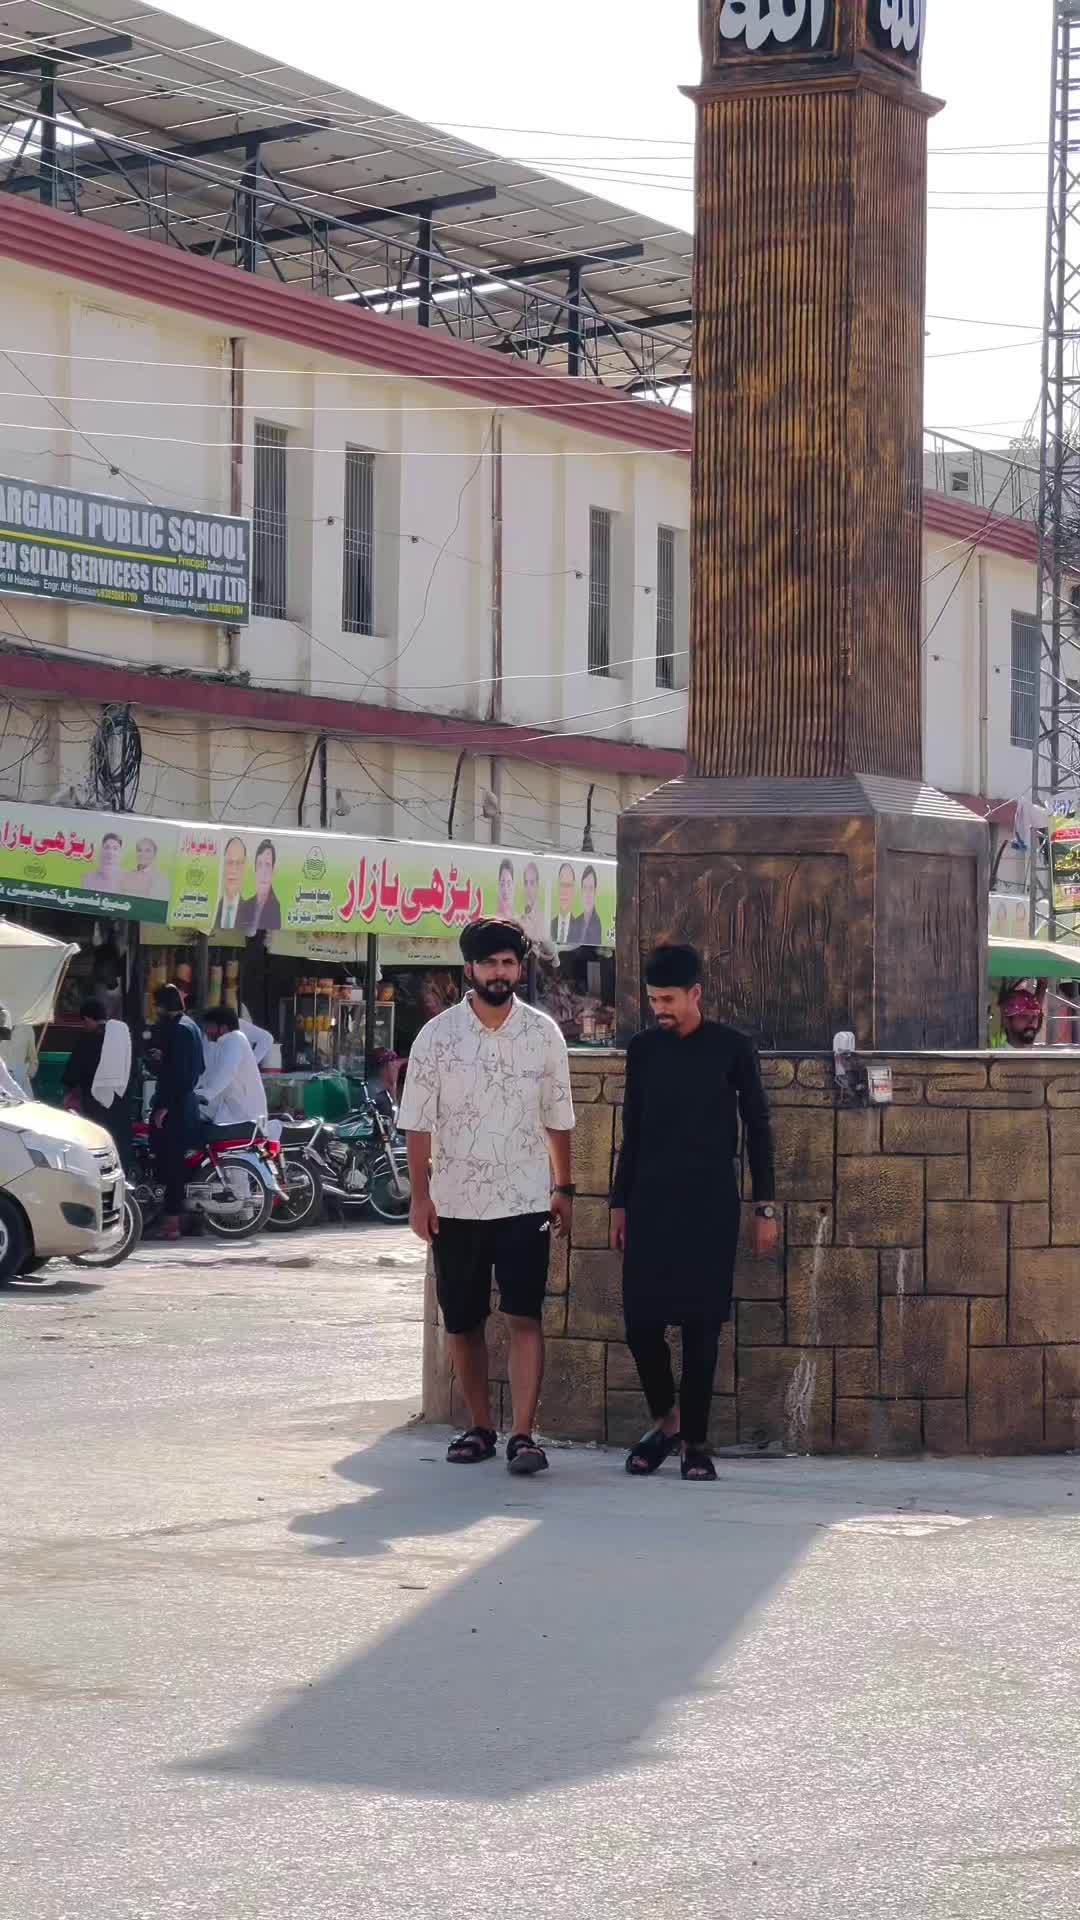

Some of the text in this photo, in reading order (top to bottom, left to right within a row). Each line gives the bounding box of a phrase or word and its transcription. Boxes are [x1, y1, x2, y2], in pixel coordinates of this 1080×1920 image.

[88, 502, 164, 549] PUBLIC
[168, 516, 246, 561] SCHOOL
[20, 544, 68, 579] SOLAR
[197, 572, 222, 600] PVT
[225, 575, 247, 603] LTD
[0, 820, 32, 854] بازا
[339, 854, 483, 926] ریڑھی بازار
